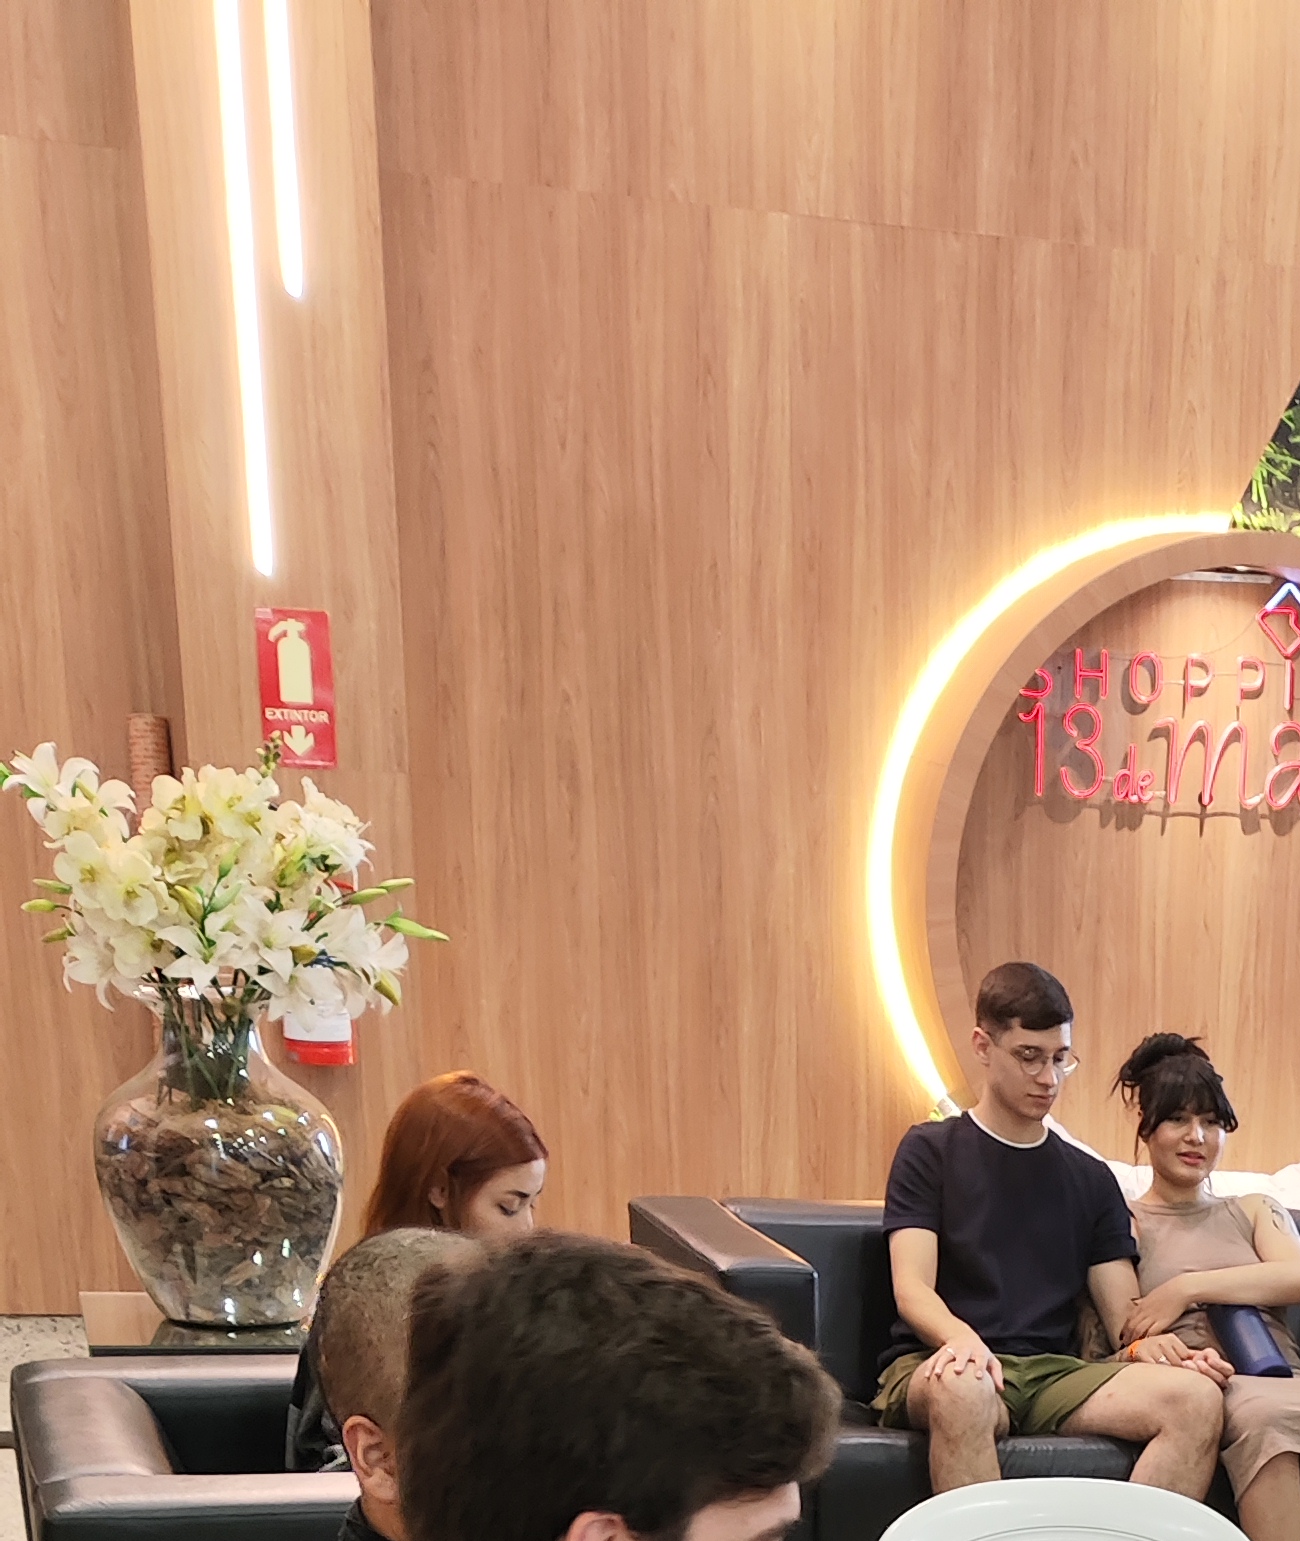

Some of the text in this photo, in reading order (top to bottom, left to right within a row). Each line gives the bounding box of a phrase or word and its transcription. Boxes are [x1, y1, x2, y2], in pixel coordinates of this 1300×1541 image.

[264, 707, 330, 725] EXTINTOR
[1018, 702, 1105, 799] 13
[1112, 743, 1156, 804] de
